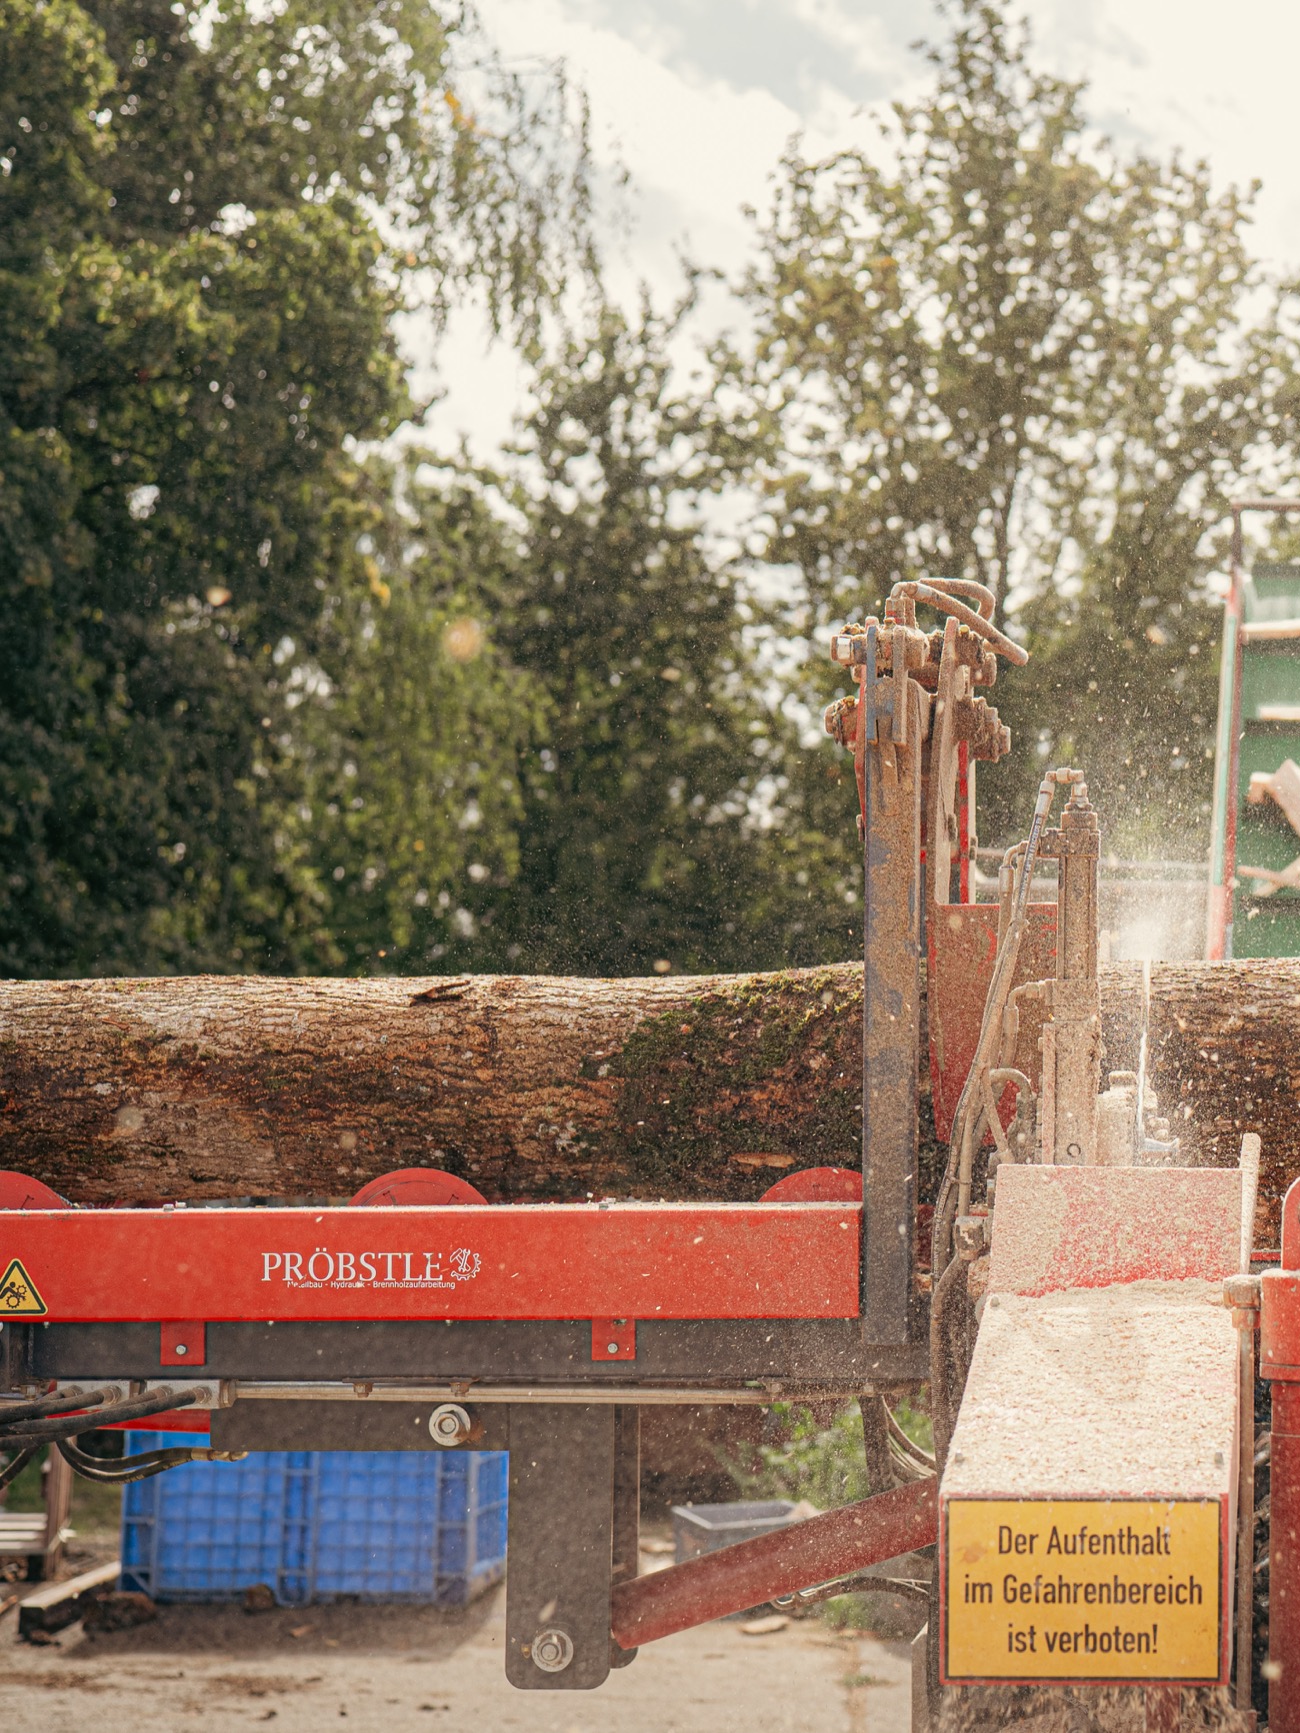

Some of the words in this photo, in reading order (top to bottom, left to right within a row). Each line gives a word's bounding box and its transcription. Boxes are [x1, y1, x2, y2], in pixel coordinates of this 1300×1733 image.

[261, 1247, 443, 1281] PRÖBSTLE
[372, 1281, 456, 1289] Brennholzaufarbeitung
[998, 1525, 1039, 1555] Der
[1047, 1525, 1171, 1555] Aufenthalt
[964, 1573, 993, 1604] im
[1002, 1573, 1203, 1605] Gefahrenbereich
[1007, 1623, 1037, 1653] ist
[1044, 1623, 1159, 1654] verboten!
